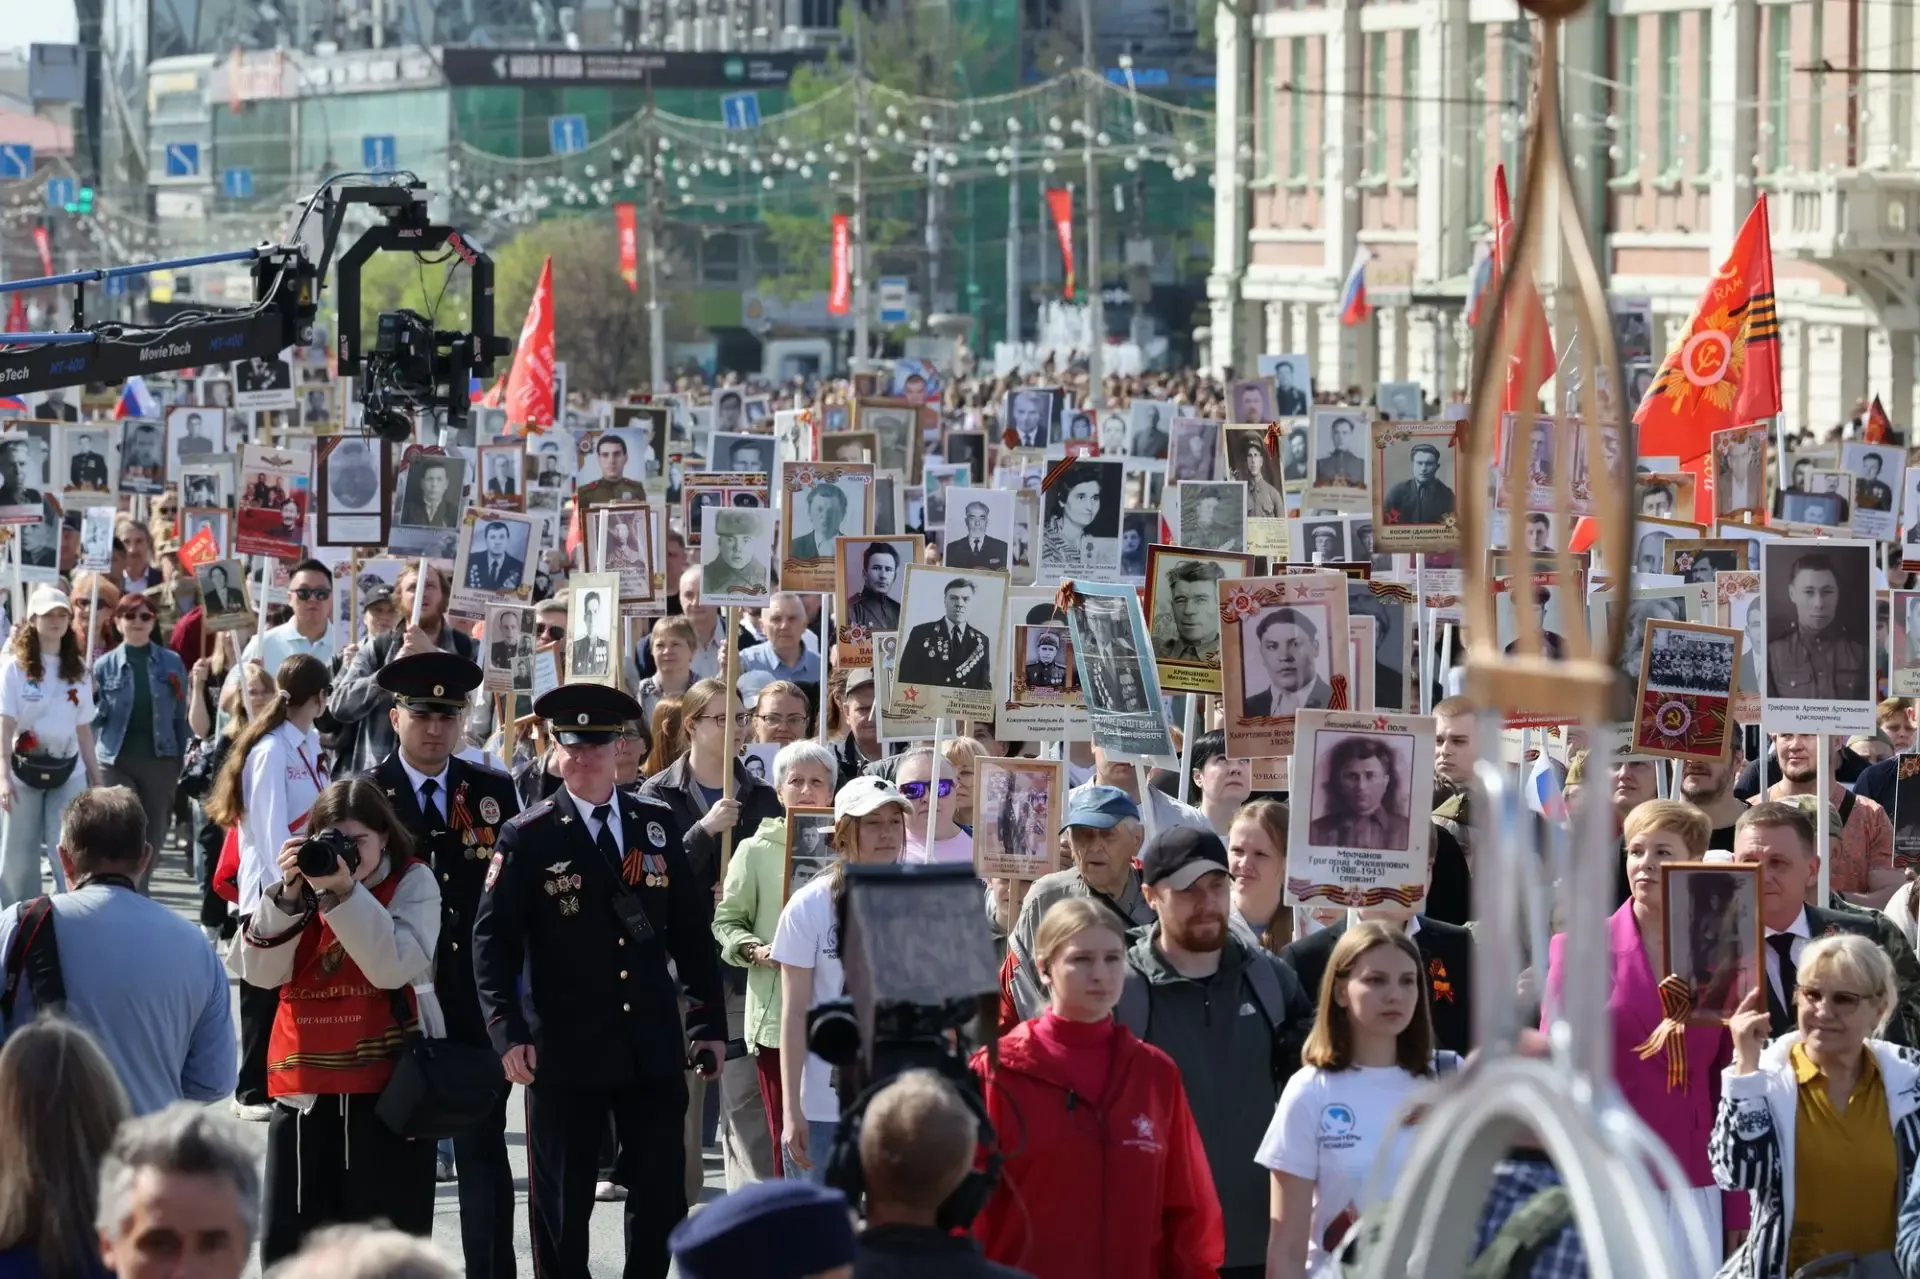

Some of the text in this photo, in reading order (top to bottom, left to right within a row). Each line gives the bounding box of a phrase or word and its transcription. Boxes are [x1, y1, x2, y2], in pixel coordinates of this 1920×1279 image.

[140, 344, 191, 361] MovieTech
[1308, 856, 1351, 868] Григорий
[1339, 875, 1377, 884] сержант
[296, 1014, 362, 1025] ОРГАНИЗАТОР
